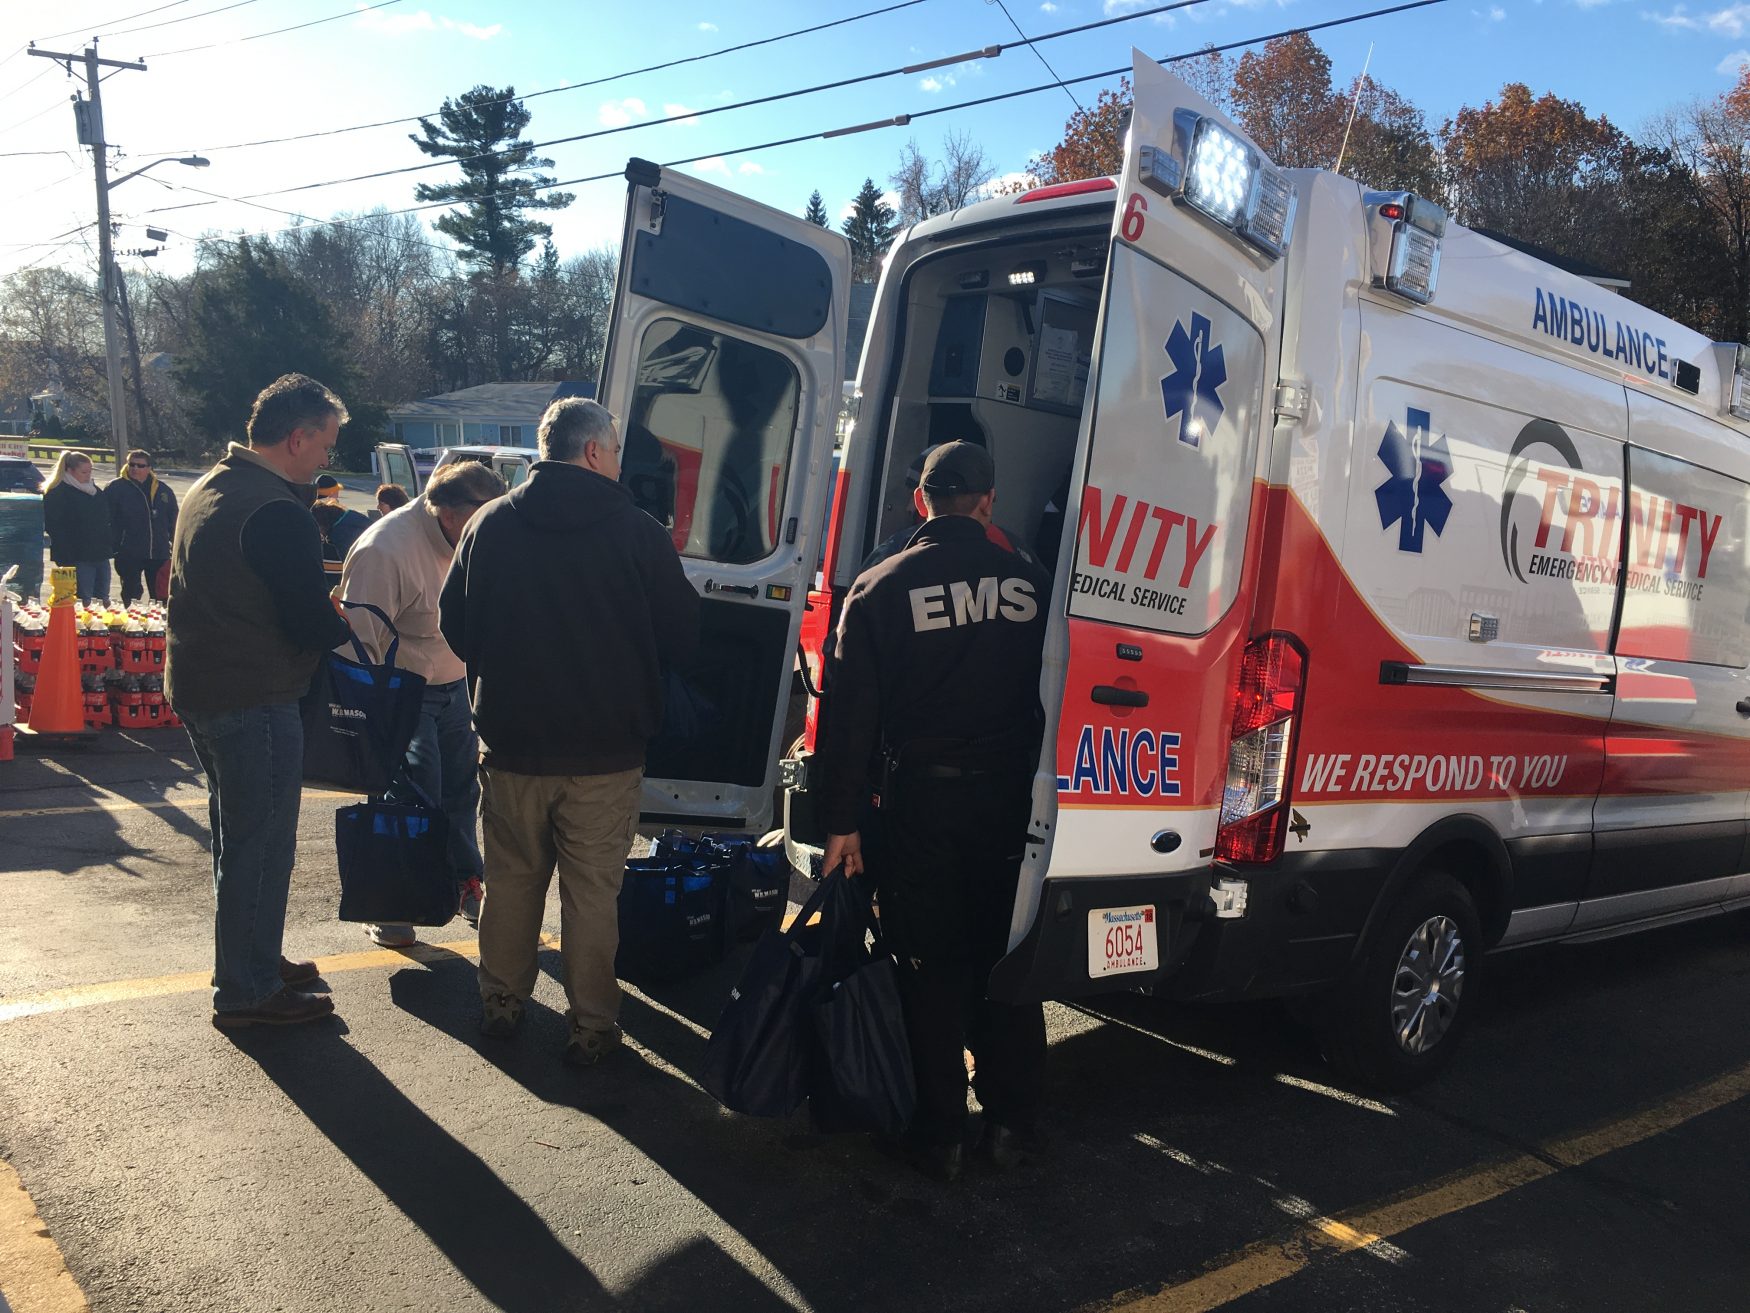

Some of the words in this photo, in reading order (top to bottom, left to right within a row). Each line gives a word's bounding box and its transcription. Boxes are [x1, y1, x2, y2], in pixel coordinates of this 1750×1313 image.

[1122, 193, 1147, 242] 6
[1532, 287, 1669, 379] AMBULANCE
[1534, 467, 1723, 579] TRINITY
[1130, 586, 1188, 616] SERVICE
[1528, 554, 1609, 585] EMERGENCY
[1609, 567, 1661, 594] MEDICAL
[1663, 577, 1704, 601] SERVICE
[908, 576, 1038, 632] EMS
[1300, 754, 1351, 793] WE
[1350, 754, 1484, 792] RESPOND
[1488, 755, 1517, 790] TO
[1518, 755, 1568, 789] YOU
[1105, 924, 1143, 959] 6054
[1106, 956, 1143, 969] AMBULANCE
